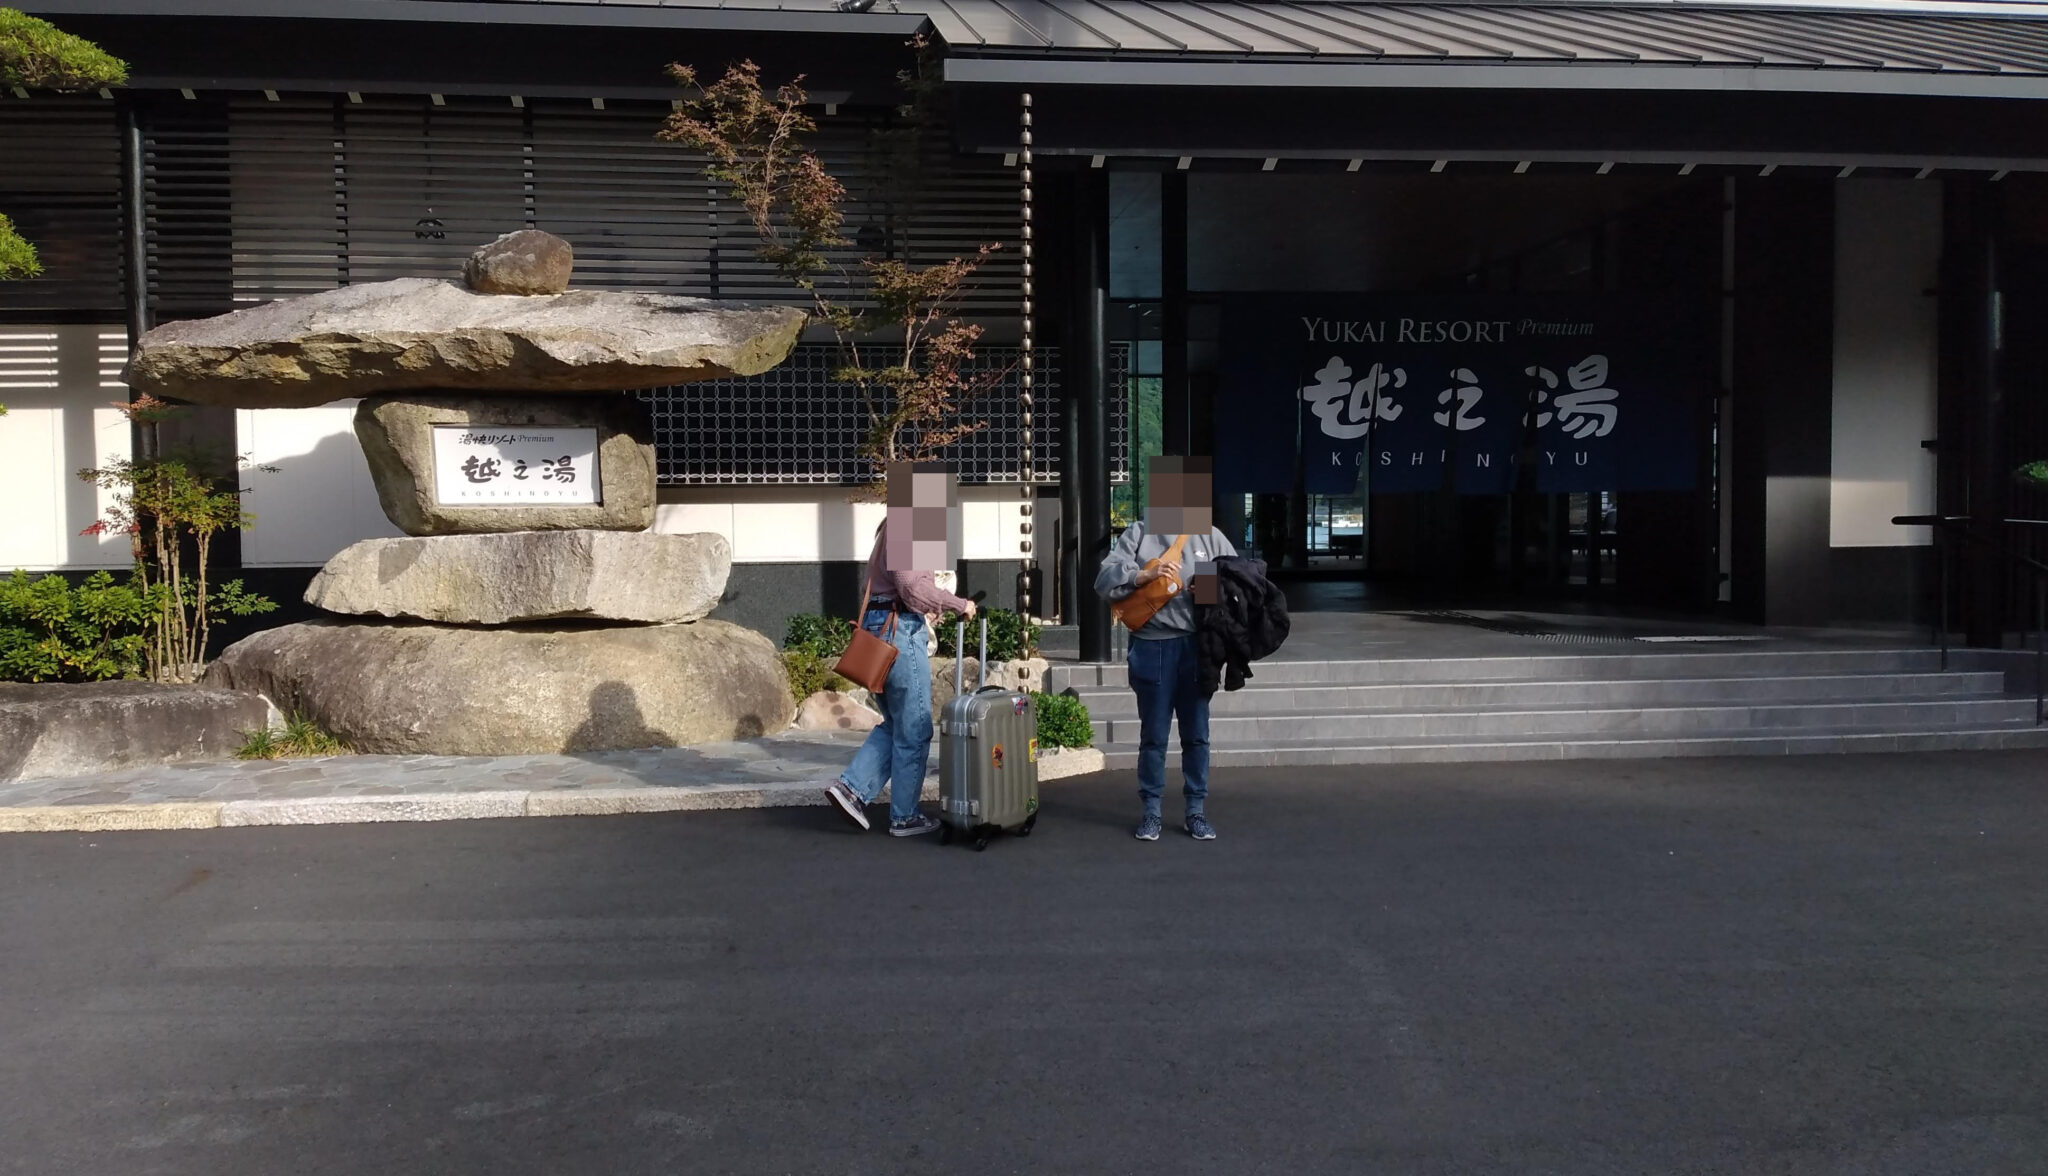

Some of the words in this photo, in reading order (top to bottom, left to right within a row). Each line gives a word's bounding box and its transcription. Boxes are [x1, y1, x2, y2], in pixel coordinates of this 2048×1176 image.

[1302, 317, 1385, 342] YUKAI
[1398, 317, 1511, 343] RESORT
[1518, 318, 1594, 336] Premium
[459, 433, 516, 445] 湯快リゾート
[518, 434, 554, 443] Premium
[461, 455, 575, 483] 越之湯
